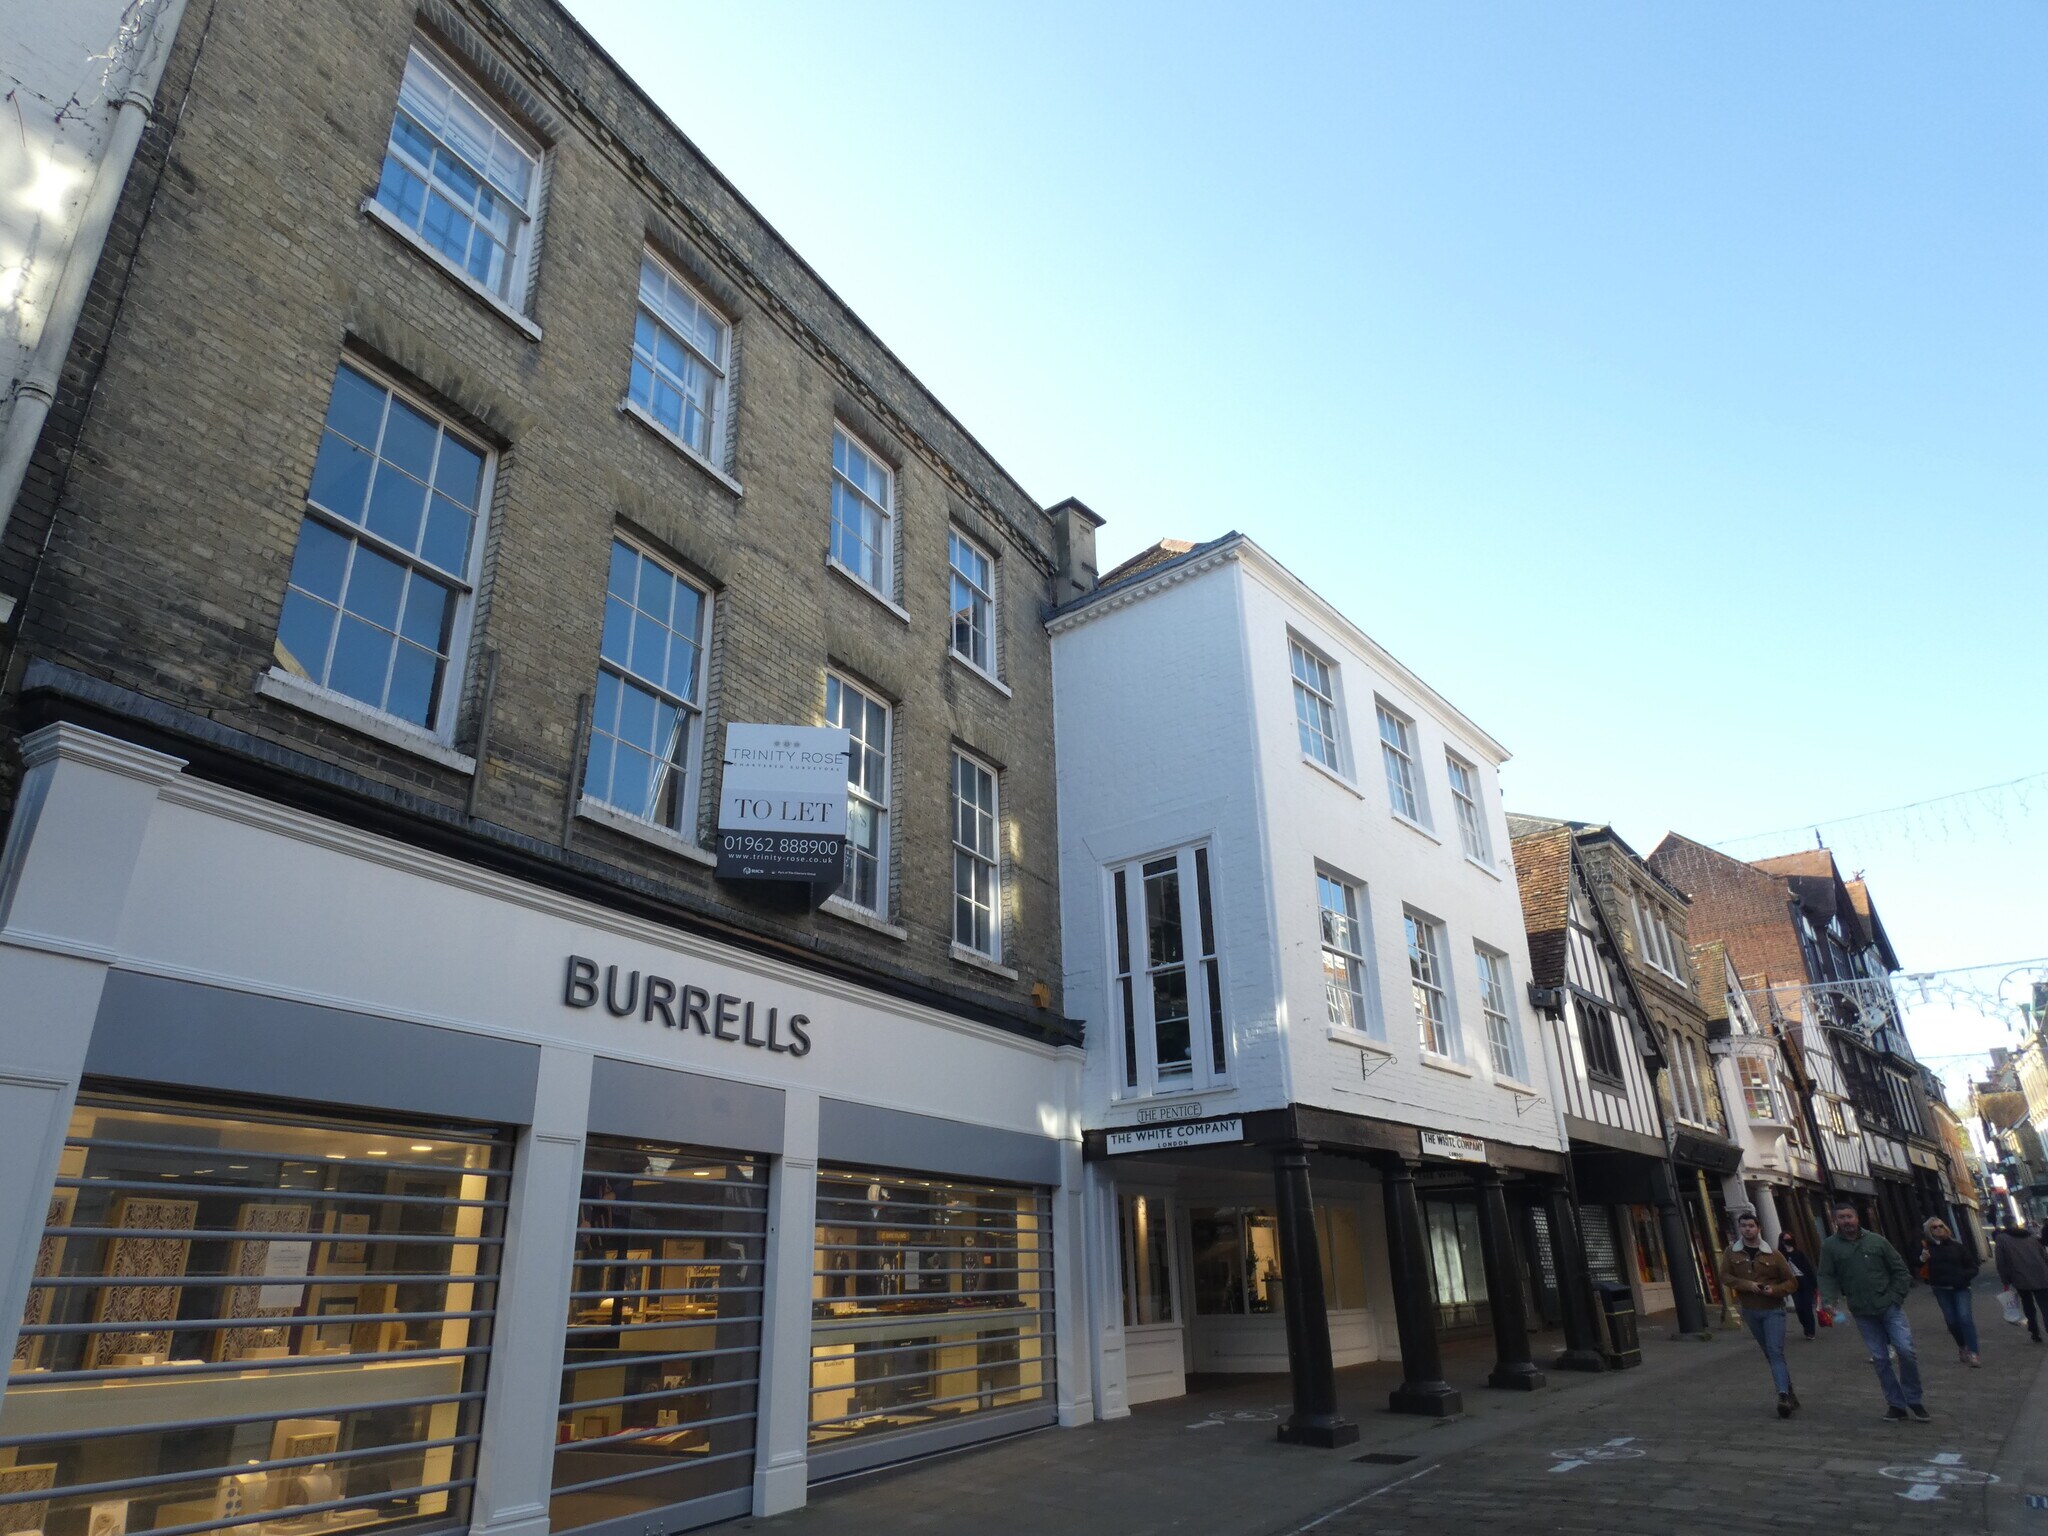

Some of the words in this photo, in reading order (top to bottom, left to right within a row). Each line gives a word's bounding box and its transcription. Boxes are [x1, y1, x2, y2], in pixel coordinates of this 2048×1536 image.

[732, 748, 796, 762] TRINITY
[801, 751, 844, 765] ROSE
[734, 798, 772, 820] TO
[781, 801, 833, 823] LET
[724, 835, 774, 852] 01962
[779, 838, 838, 855] 888900
[728, 852, 833, 864] www.trinity-rose.co.uk
[564, 954, 812, 1057] BURRELLS
[1139, 1109, 1157, 1122] THE
[1160, 1104, 1200, 1120] PENTICE
[1111, 1134, 1132, 1145] THE
[1135, 1128, 1172, 1141] WHITE
[1177, 1121, 1237, 1137] COMPANY
[1424, 1133, 1436, 1145] THE
[1436, 1135, 1456, 1148] WHITE
[1456, 1138, 1483, 1152] COMPANY
[1157, 1140, 1189, 1148] LONDON
